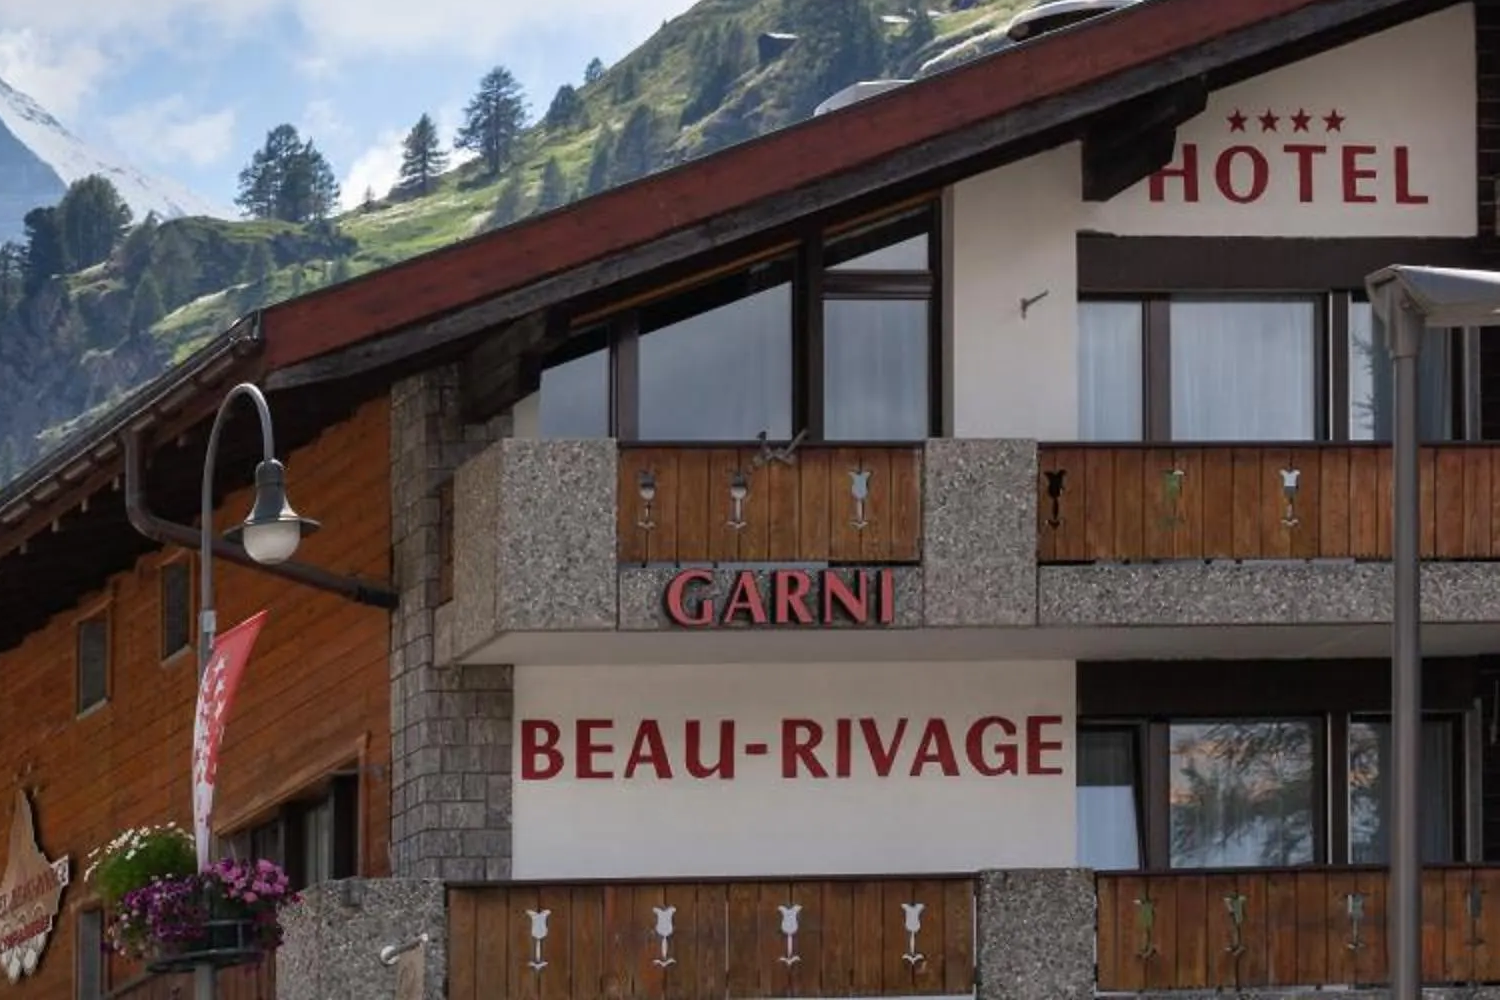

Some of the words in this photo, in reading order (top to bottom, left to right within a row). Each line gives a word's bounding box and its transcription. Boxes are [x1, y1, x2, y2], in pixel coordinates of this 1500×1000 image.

[1148, 143, 1430, 205] HOTEL
[664, 567, 897, 628] GARNI
[519, 714, 1064, 781] BEAU-RIVAGE
